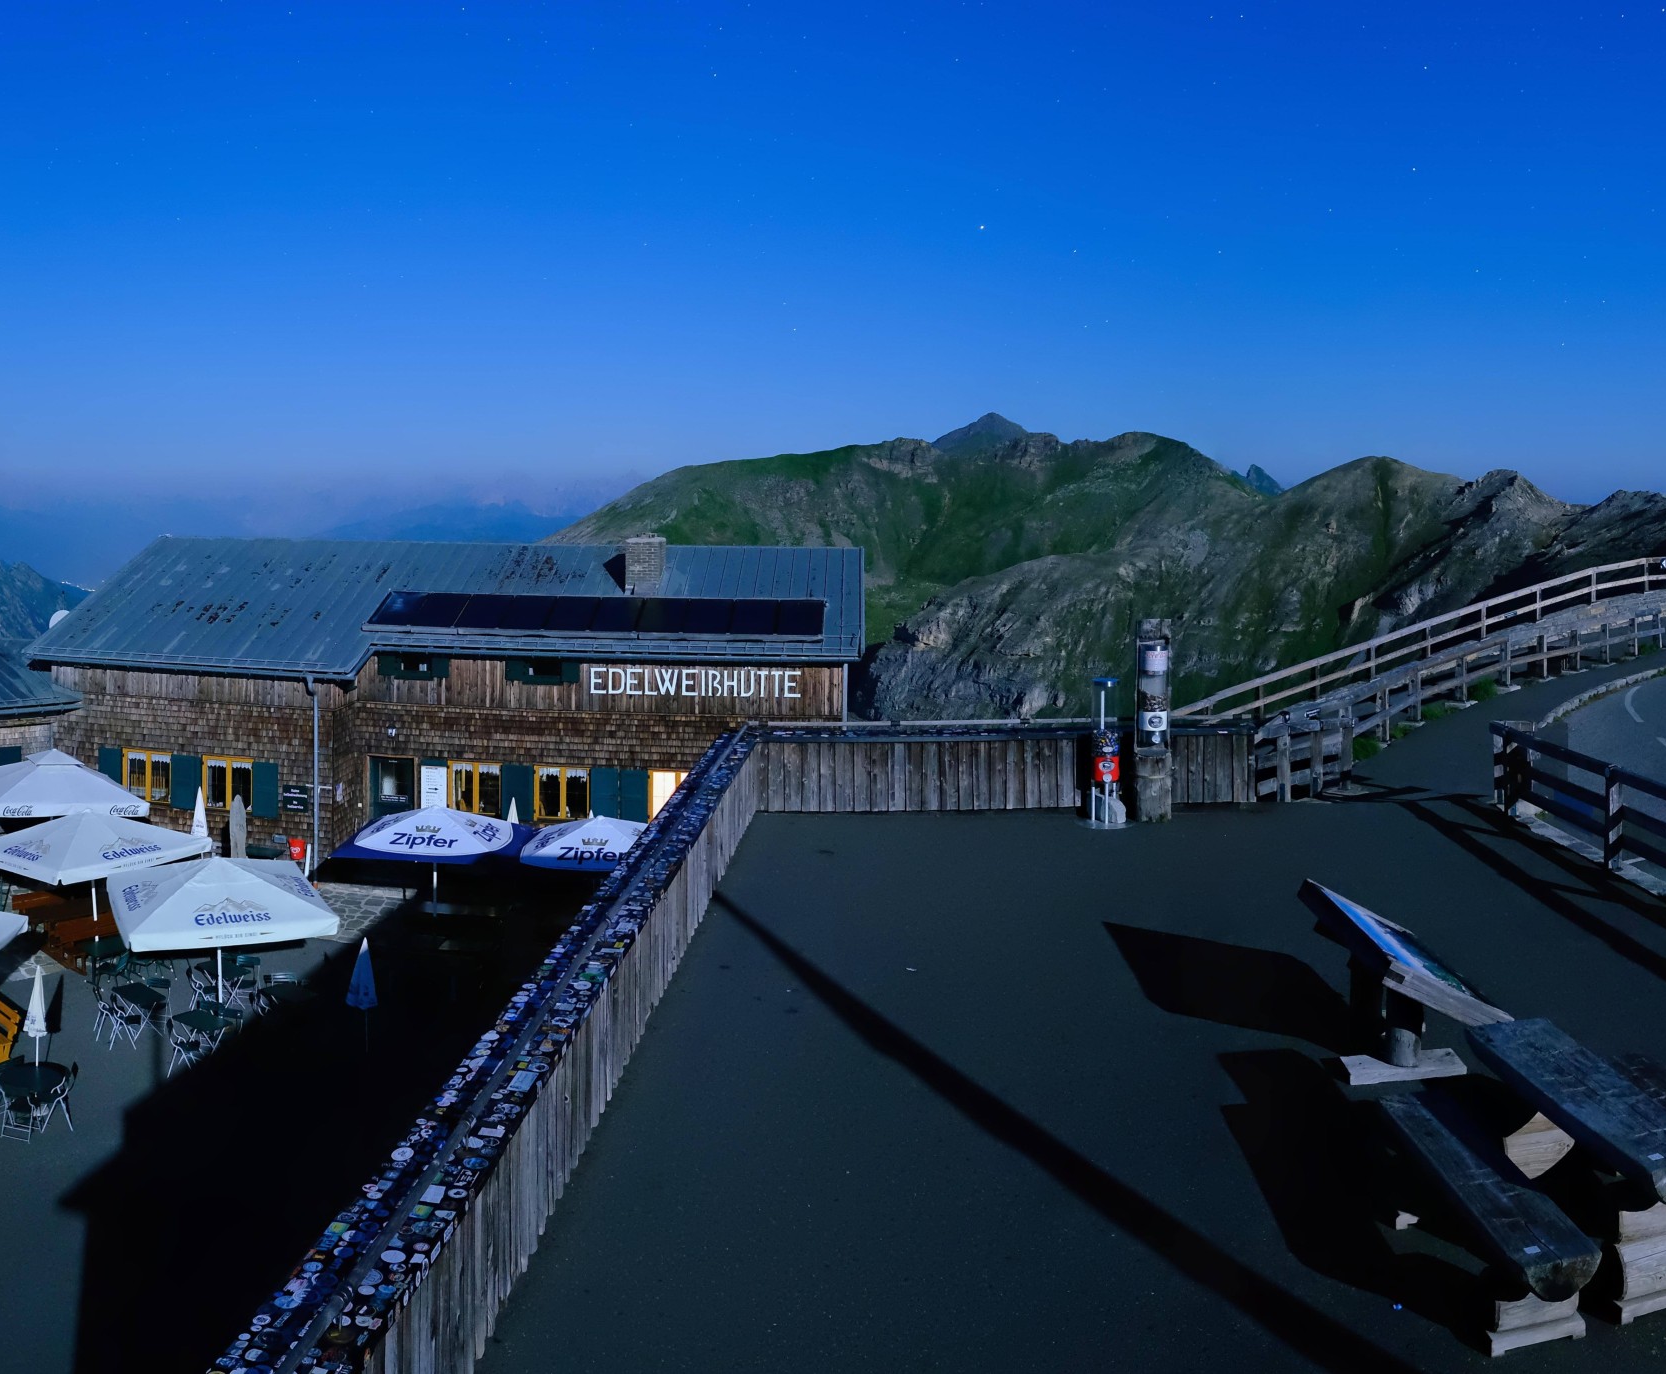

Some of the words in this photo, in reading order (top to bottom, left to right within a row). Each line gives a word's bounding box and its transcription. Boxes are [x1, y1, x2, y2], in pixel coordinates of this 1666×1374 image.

[389, 832, 458, 849] Zipfer
[102, 844, 161, 862] Edelweiss
[195, 910, 271, 926] Edelweiss
